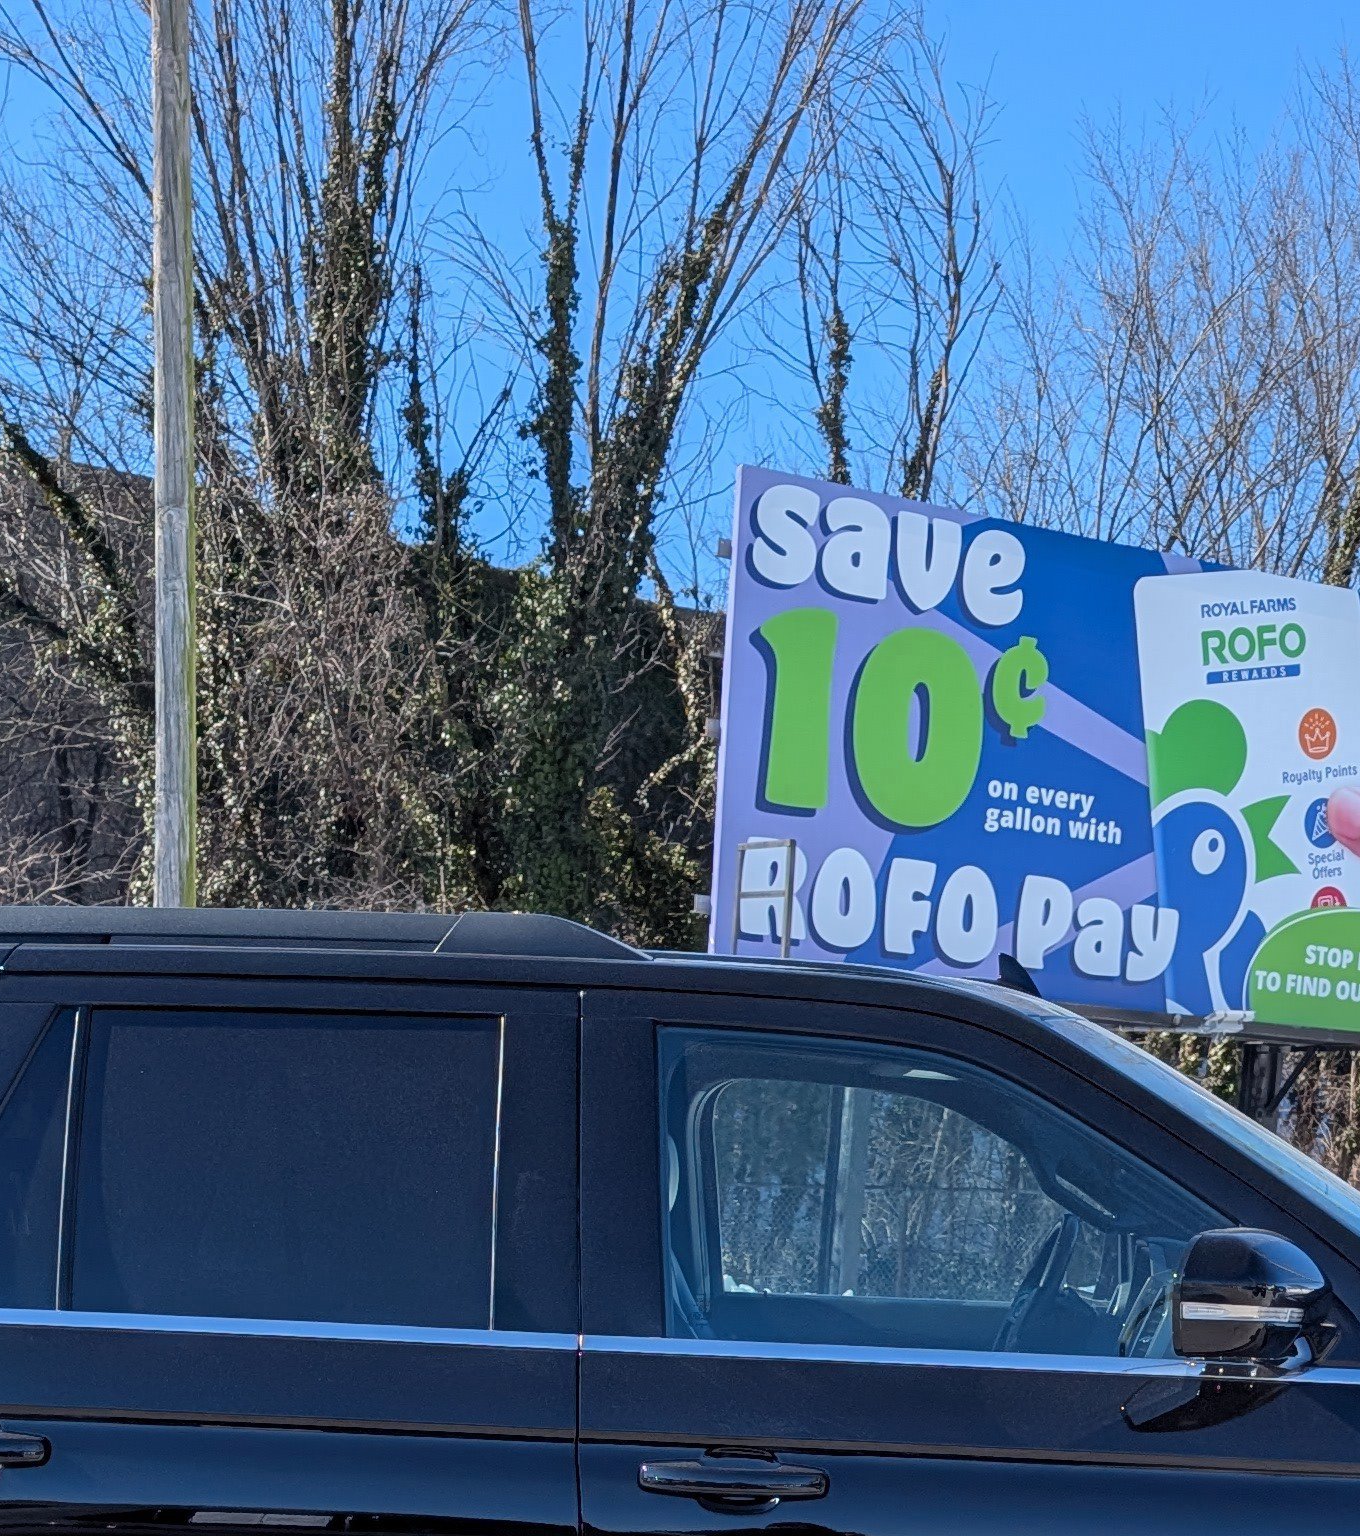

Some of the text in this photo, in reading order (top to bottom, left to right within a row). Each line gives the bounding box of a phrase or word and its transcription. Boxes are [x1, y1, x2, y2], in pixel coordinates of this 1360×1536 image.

[1200, 597, 1297, 619] ROYAL FARMS
[1200, 622, 1307, 666] ROFO
[1221, 665, 1288, 683] REWARDS
[1282, 764, 1359, 786] Royalty Points
[987, 779, 1096, 819] on every
[983, 806, 1123, 845] gallon with
[1307, 848, 1345, 868] Special
[1312, 864, 1343, 880] Offers
[739, 836, 1180, 983] ROFO Pay
[1304, 944, 1355, 969] STOP
[1255, 970, 1282, 993] TO
[1285, 973, 1332, 998] FIND
